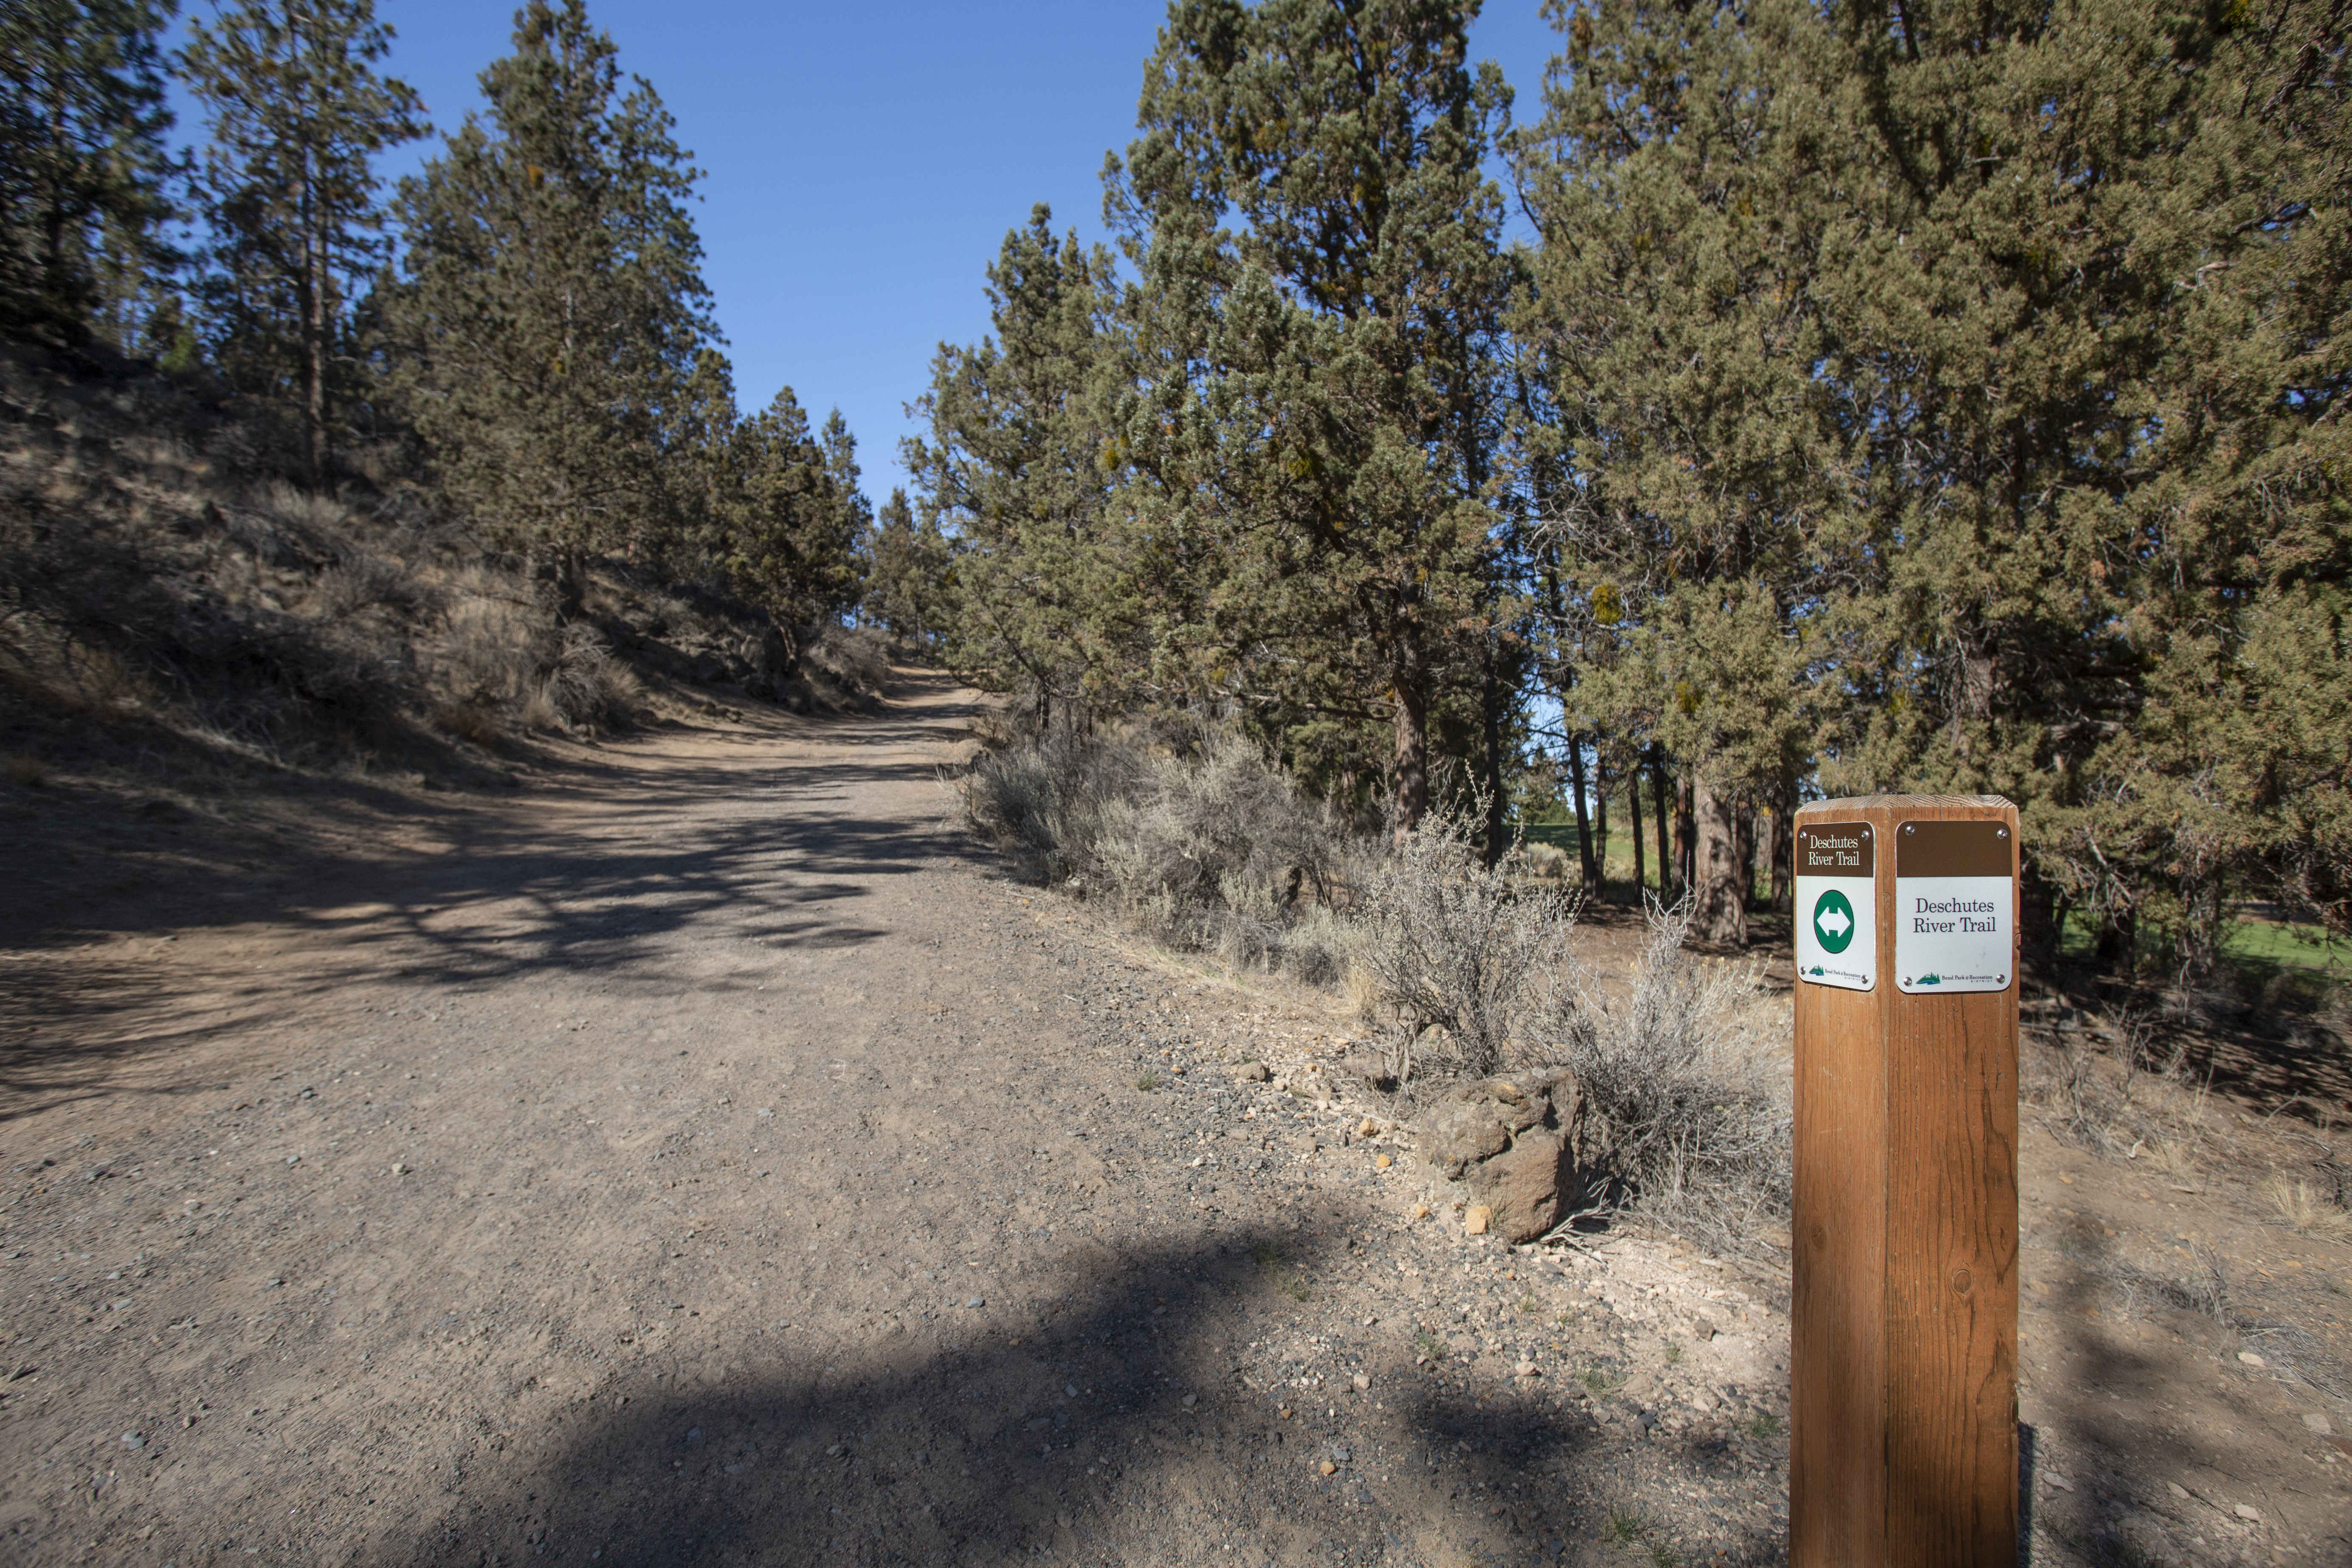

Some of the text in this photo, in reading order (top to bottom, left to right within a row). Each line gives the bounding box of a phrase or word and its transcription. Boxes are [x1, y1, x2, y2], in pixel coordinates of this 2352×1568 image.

[1810, 834, 1858, 849] Deschutes
[1808, 851, 1860, 866] River Trail
[1915, 898, 1994, 913] Deschutes
[1913, 917, 1997, 933] River Trail
